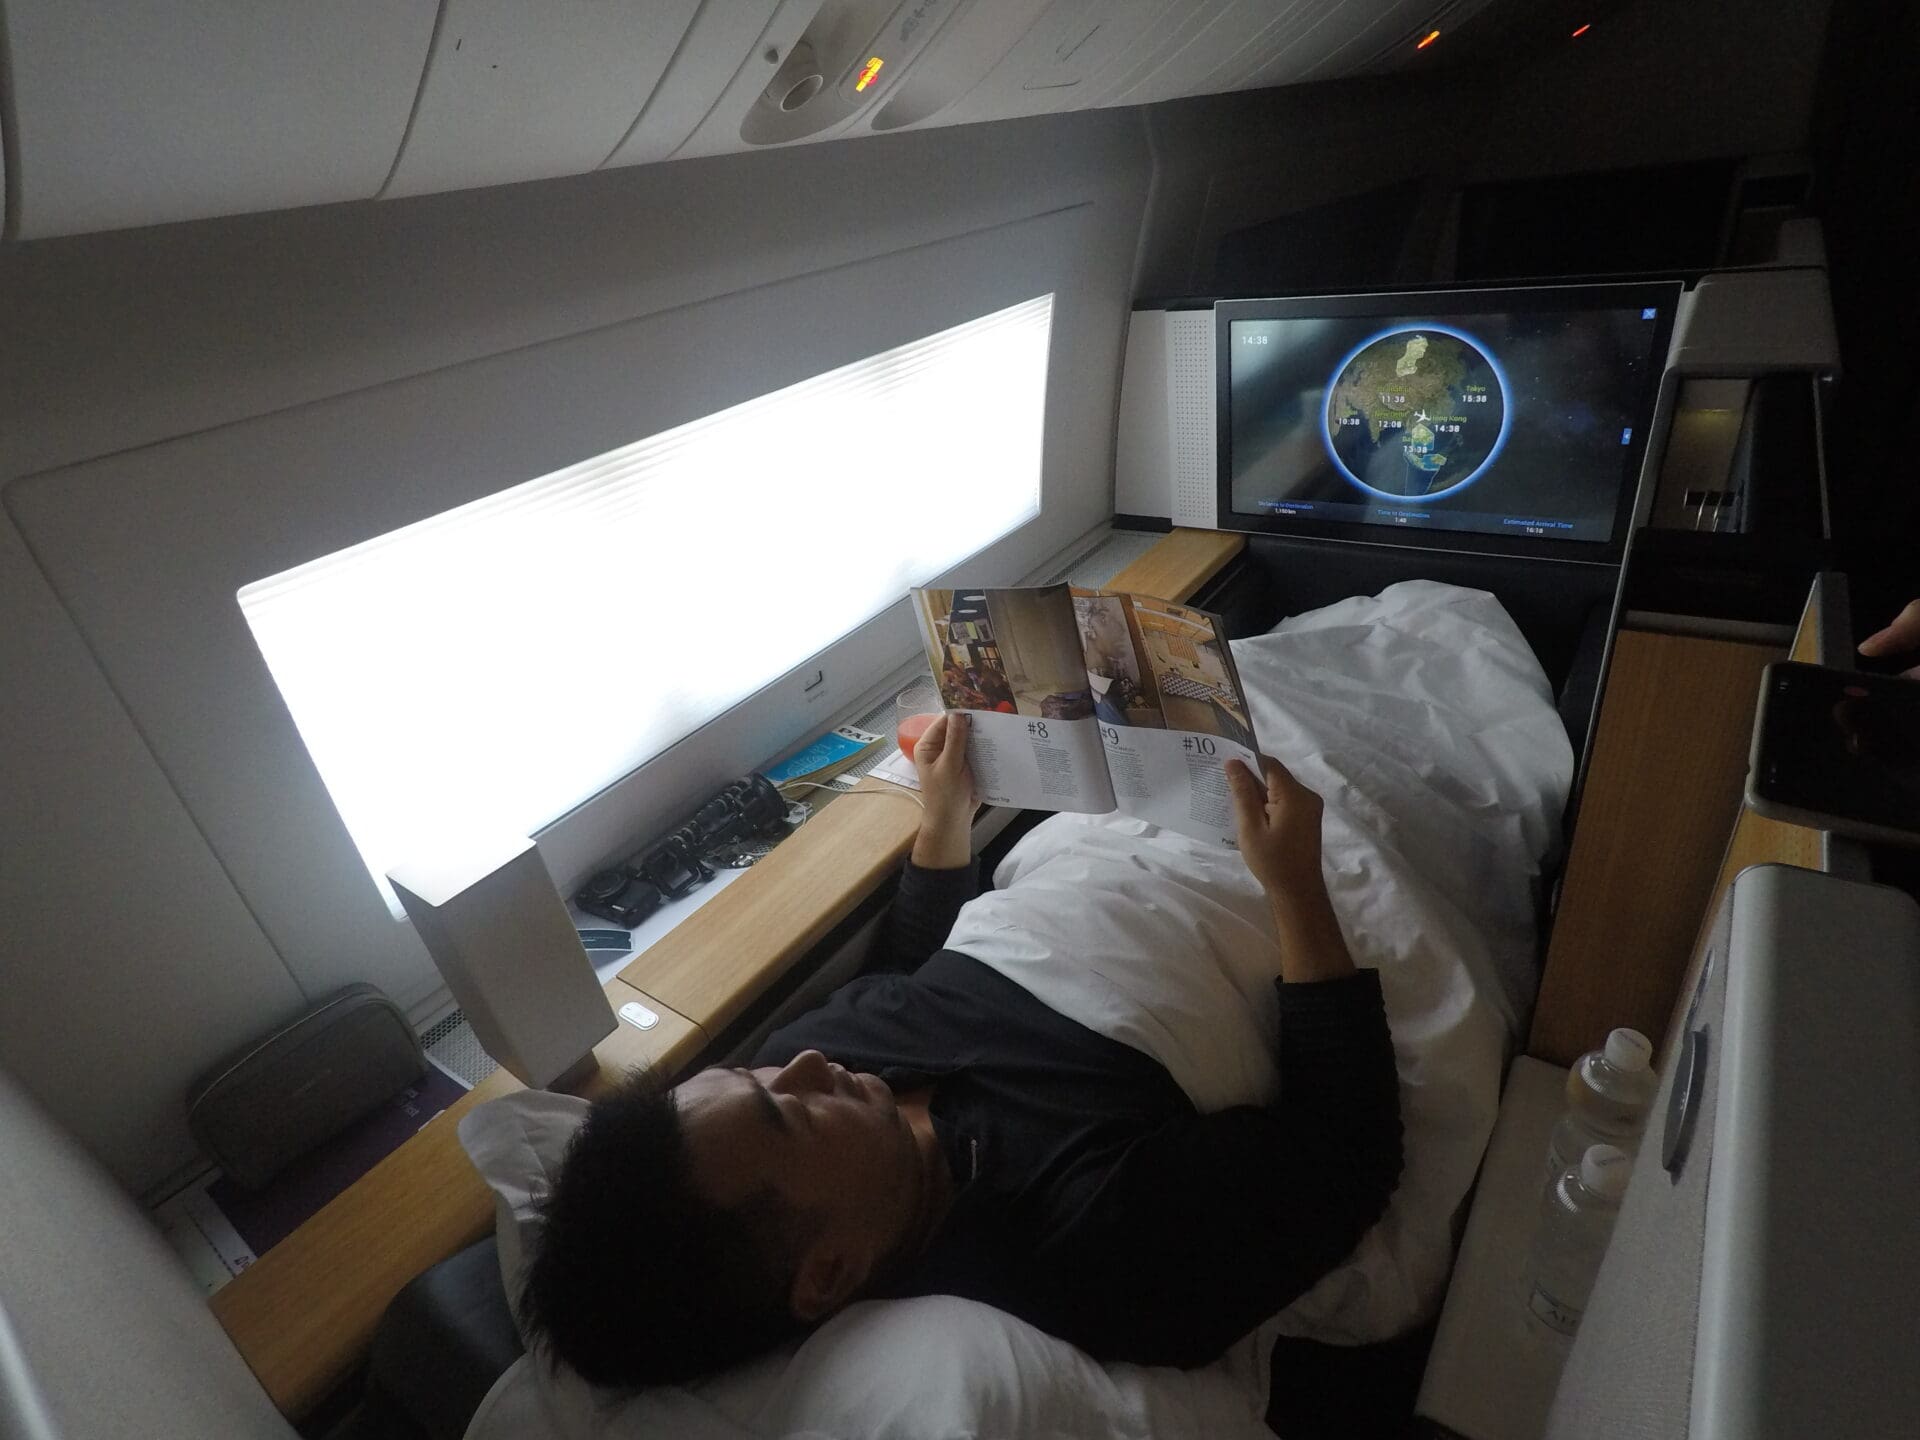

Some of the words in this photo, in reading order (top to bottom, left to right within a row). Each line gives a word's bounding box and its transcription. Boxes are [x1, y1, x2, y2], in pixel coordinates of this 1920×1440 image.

[1242, 336, 1268, 345] 14:38
[1462, 394, 1487, 403] 15:38
[1434, 424, 1460, 433] 14:38
[1027, 721, 1049, 739] #8
[1101, 727, 1119, 745] #9
[1182, 735, 1216, 756] #10
